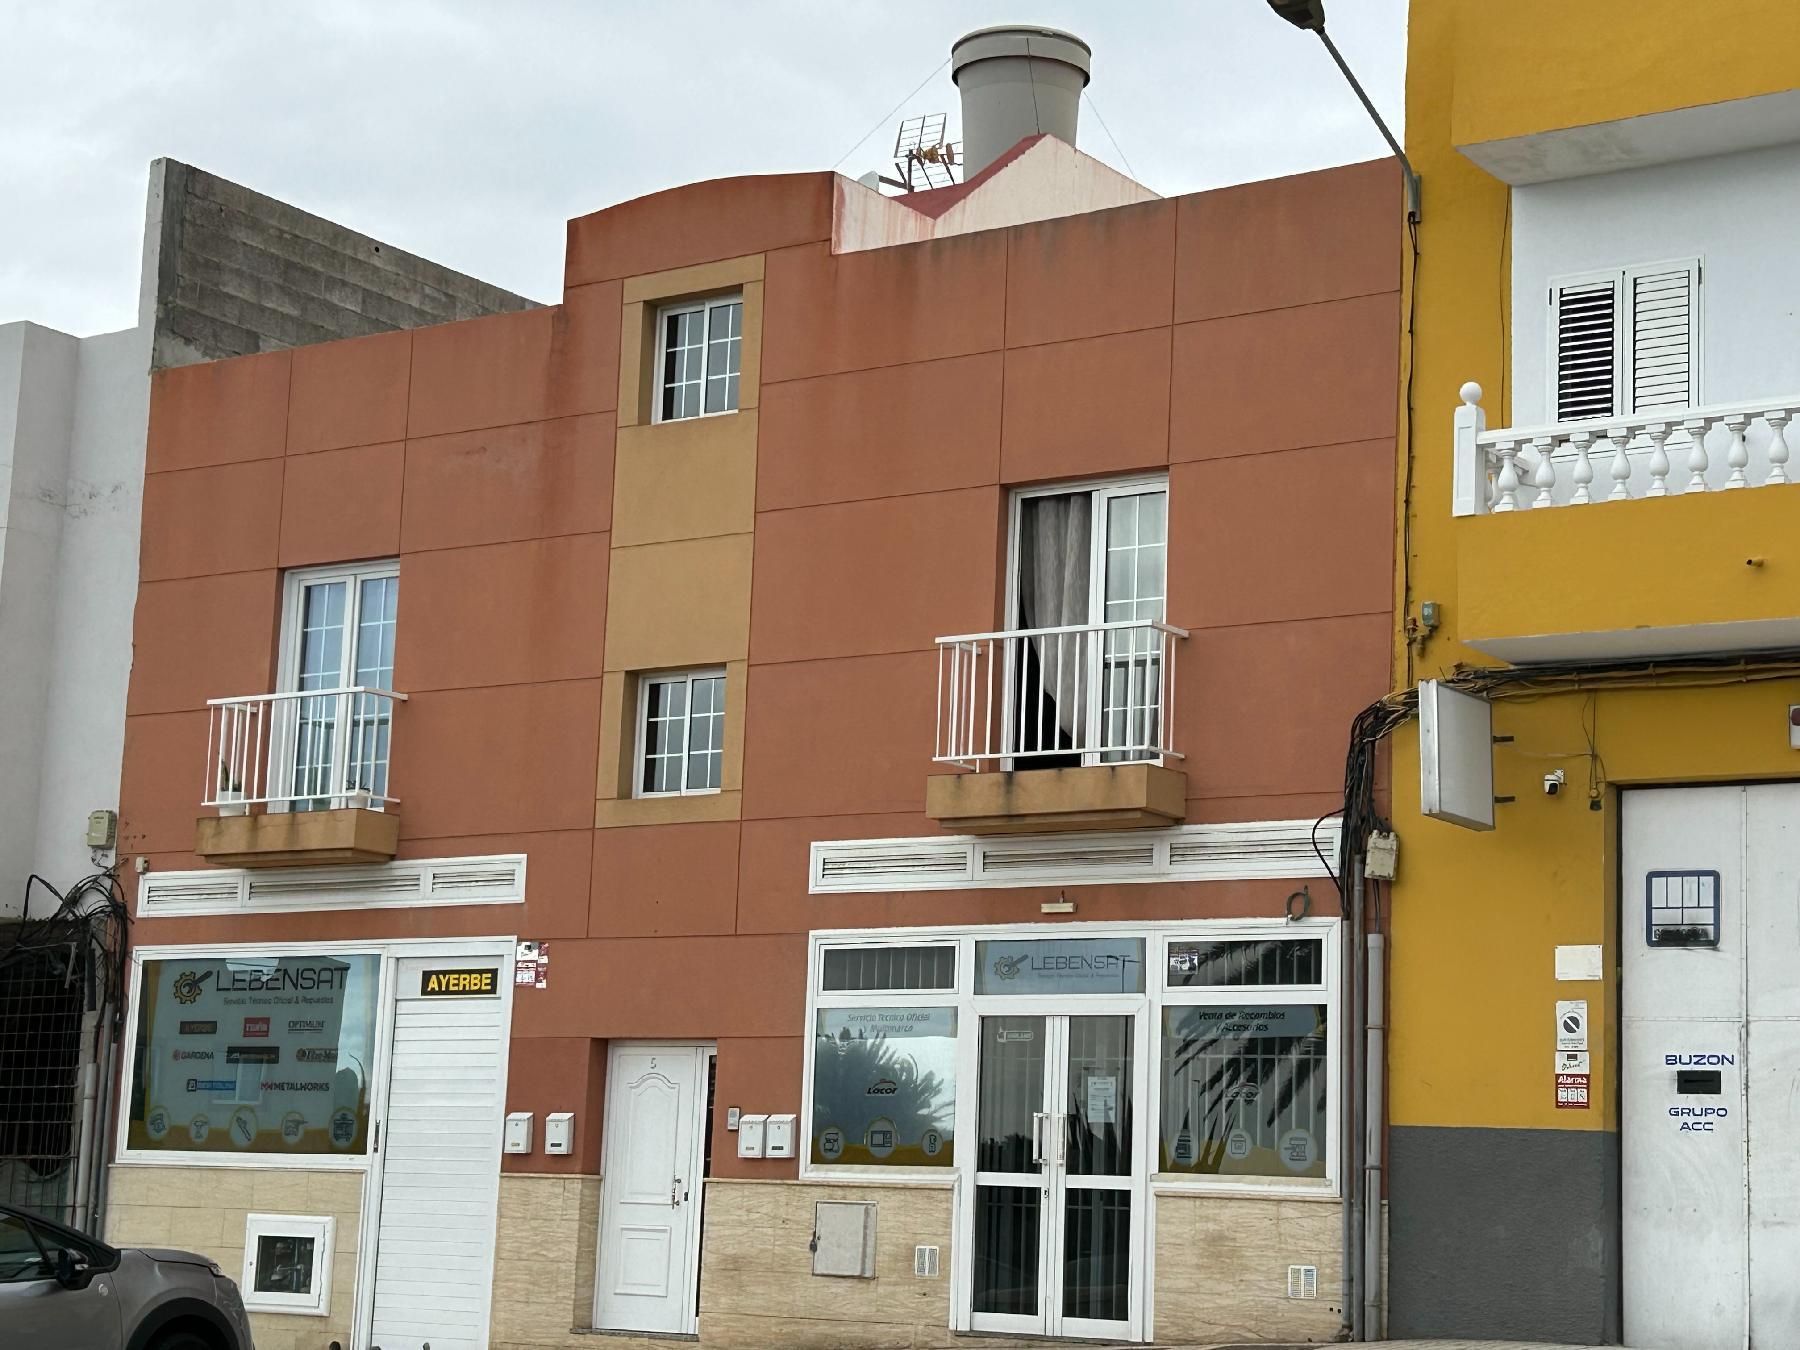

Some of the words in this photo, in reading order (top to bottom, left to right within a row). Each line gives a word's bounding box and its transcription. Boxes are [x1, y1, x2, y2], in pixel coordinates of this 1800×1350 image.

[1031, 954, 1130, 971] LEBENSAT
[216, 967, 348, 991] LEBENSAT
[427, 973, 492, 991] AYERBE
[1199, 1011, 1223, 1020] Venta
[1225, 1011, 1237, 1020] de
[1238, 1011, 1286, 1020] Recambios
[650, 1057, 657, 1070] 5
[1665, 1054, 1735, 1066] BUZON
[1668, 1107, 1728, 1118] GRUPO
[1680, 1121, 1714, 1131] ACC
